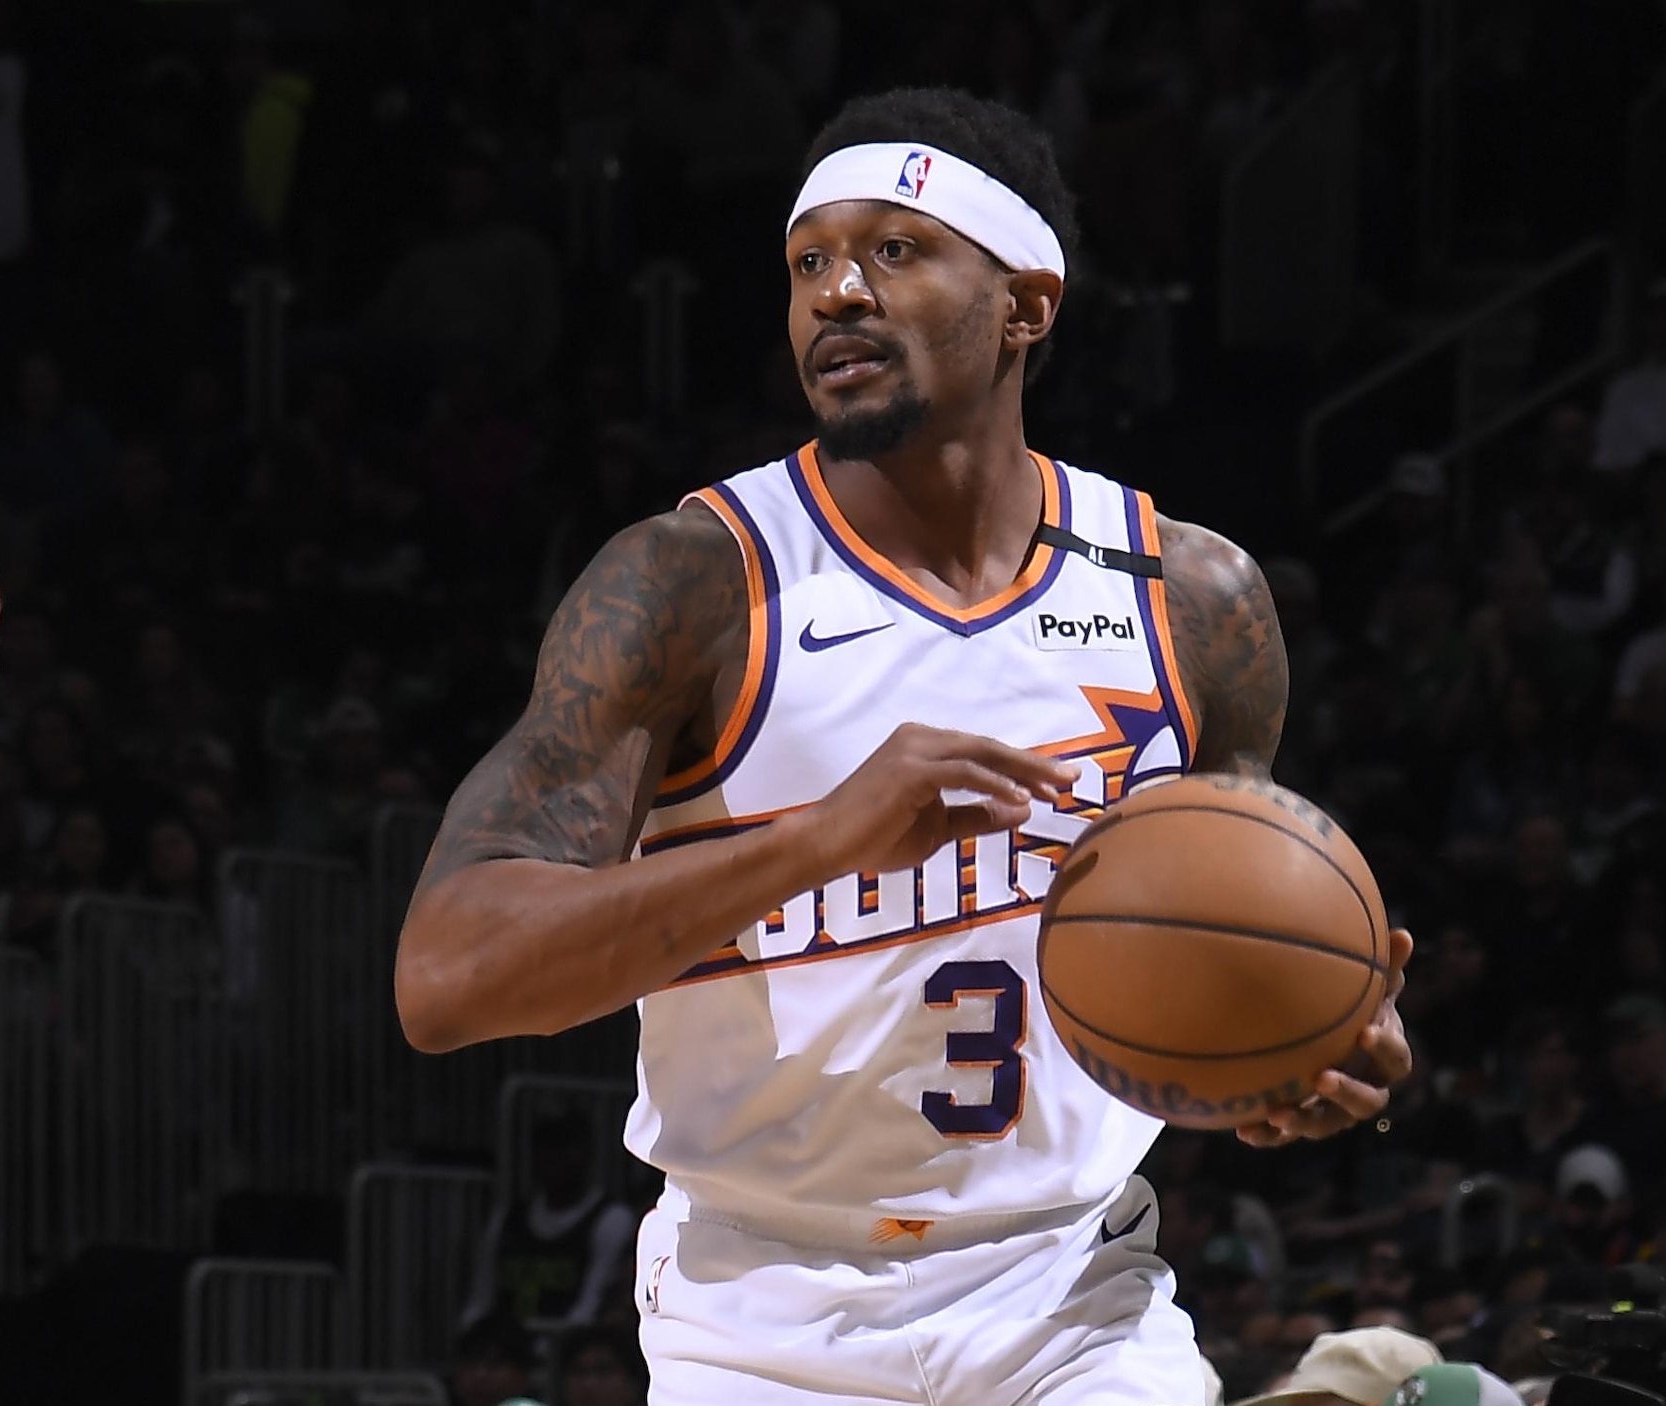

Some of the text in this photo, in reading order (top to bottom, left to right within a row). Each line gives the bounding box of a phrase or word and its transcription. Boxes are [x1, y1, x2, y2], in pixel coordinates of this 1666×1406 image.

[1088, 546, 1107, 566] AL
[1038, 614, 1135, 645] PayPal
[921, 959, 1028, 1141] 3
